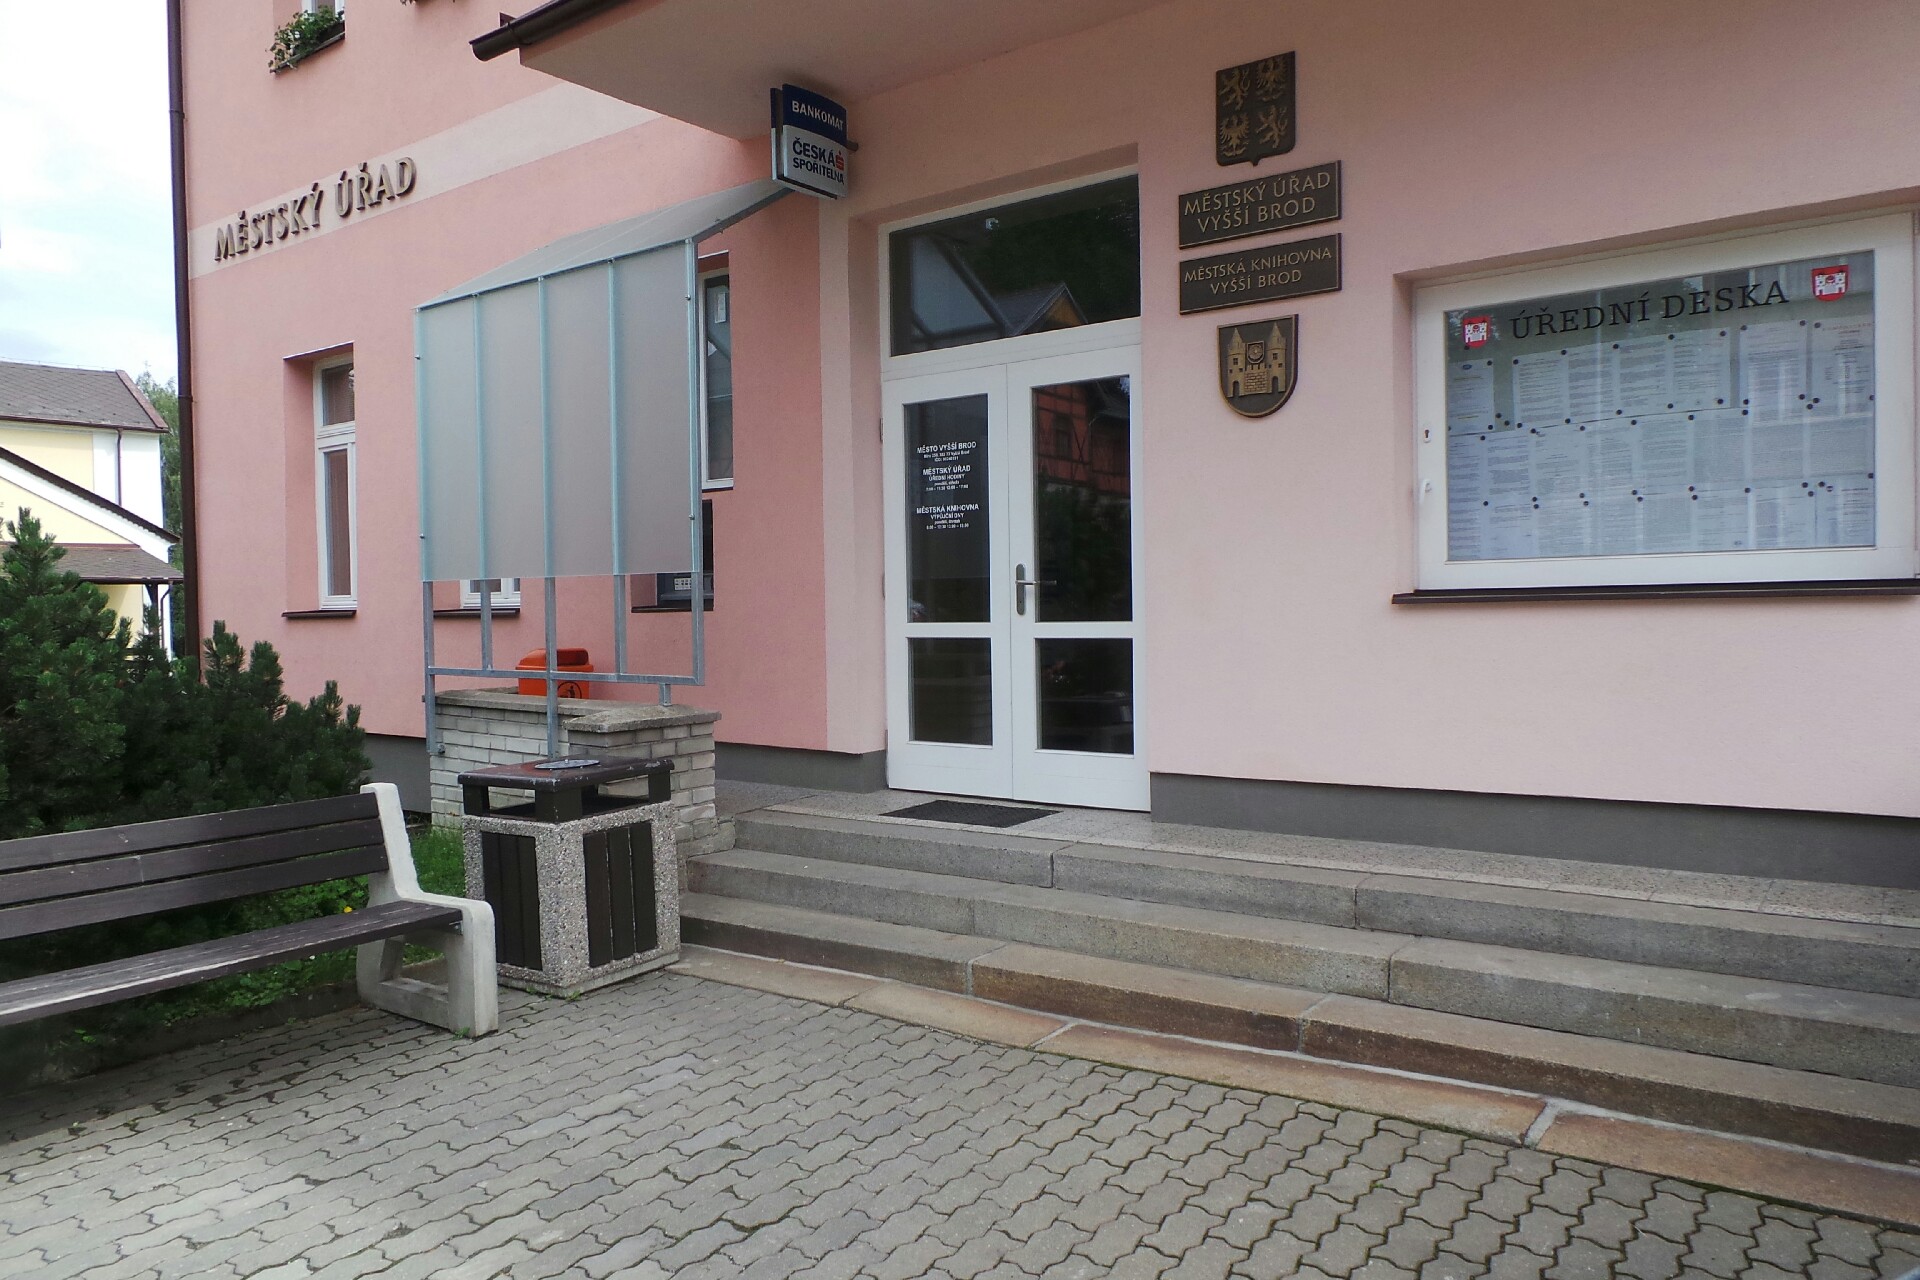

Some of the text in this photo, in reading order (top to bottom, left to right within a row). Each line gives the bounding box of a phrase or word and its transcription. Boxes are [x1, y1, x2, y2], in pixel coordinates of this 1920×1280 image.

[791, 100, 844, 131] BANKOMAT
[792, 137, 836, 168] ČESKÁ
[792, 157, 845, 185] SPOŘITELNA
[214, 156, 418, 262] MĚSTSKÝ ÚŘAD
[1184, 171, 1332, 217] MĚSTSKÝ ÚŘAD
[1197, 196, 1316, 234] VYŠŠÍ BROD
[1184, 247, 1332, 283] MĚSTSKÁ KNIHOVNA
[1210, 269, 1303, 296] VYŠŠÍ BROD
[1509, 279, 1789, 340] ÚŘEDNÍ DESKA
[916, 441, 976, 454] MĚSTO VYŠŠÍ BROD
[922, 464, 970, 475] MĚSTSKÝ ÚŘAD
[916, 503, 979, 514] MĚSTSKÁ KNIHOVNA
